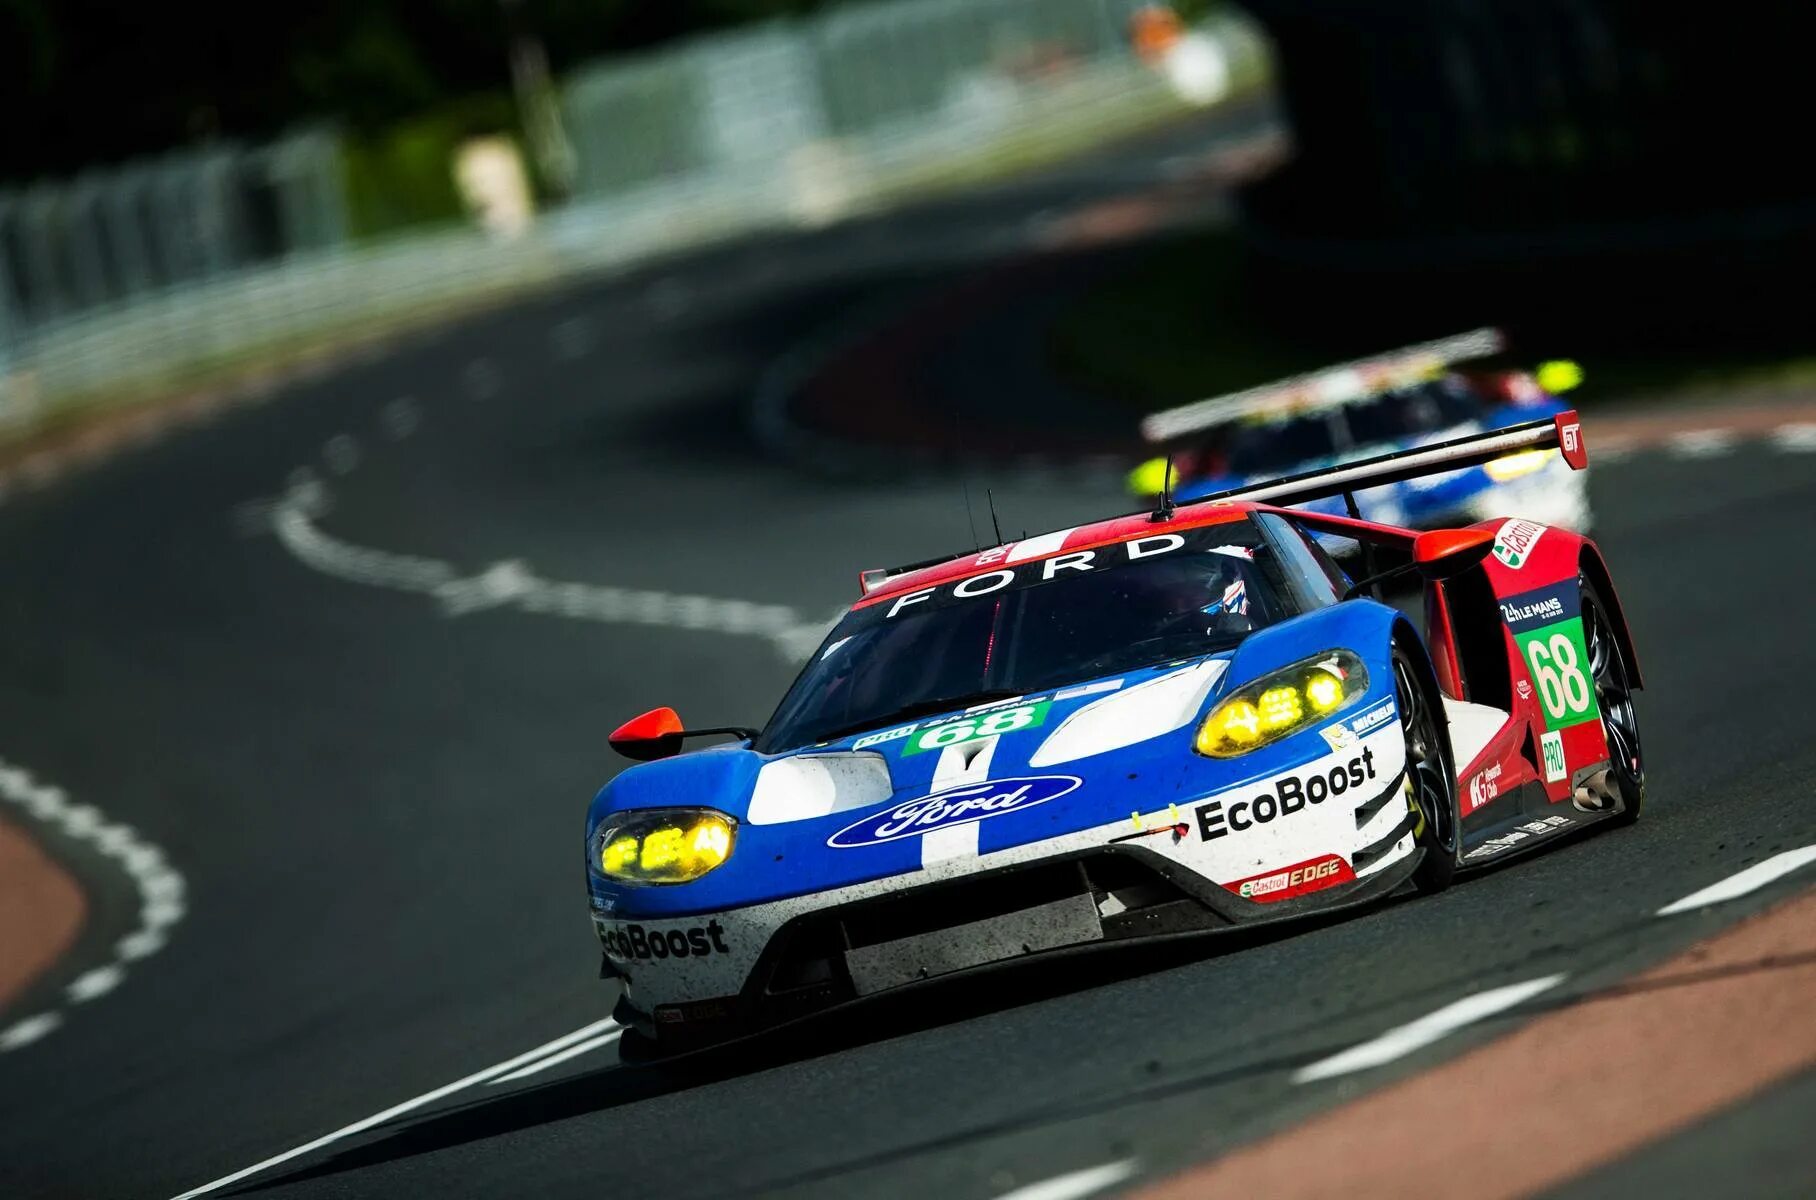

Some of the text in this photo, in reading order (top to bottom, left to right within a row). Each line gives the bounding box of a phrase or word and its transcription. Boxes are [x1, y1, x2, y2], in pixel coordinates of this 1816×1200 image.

[1562, 424, 1580, 452] GT
[886, 534, 1185, 618] FORD
[1521, 607, 1534, 619] LE
[1533, 597, 1562, 615] MANS
[1528, 633, 1589, 718] 68
[859, 725, 912, 746] PRO
[918, 706, 1036, 749] 68
[1353, 702, 1395, 731] MICHELIN
[1543, 739, 1563, 773] PRO
[875, 784, 1033, 837] Ford
[1195, 746, 1376, 842] EcoBoost
[1252, 857, 1341, 895] Castrol EDGE
[597, 919, 729, 959] EcoBoost
